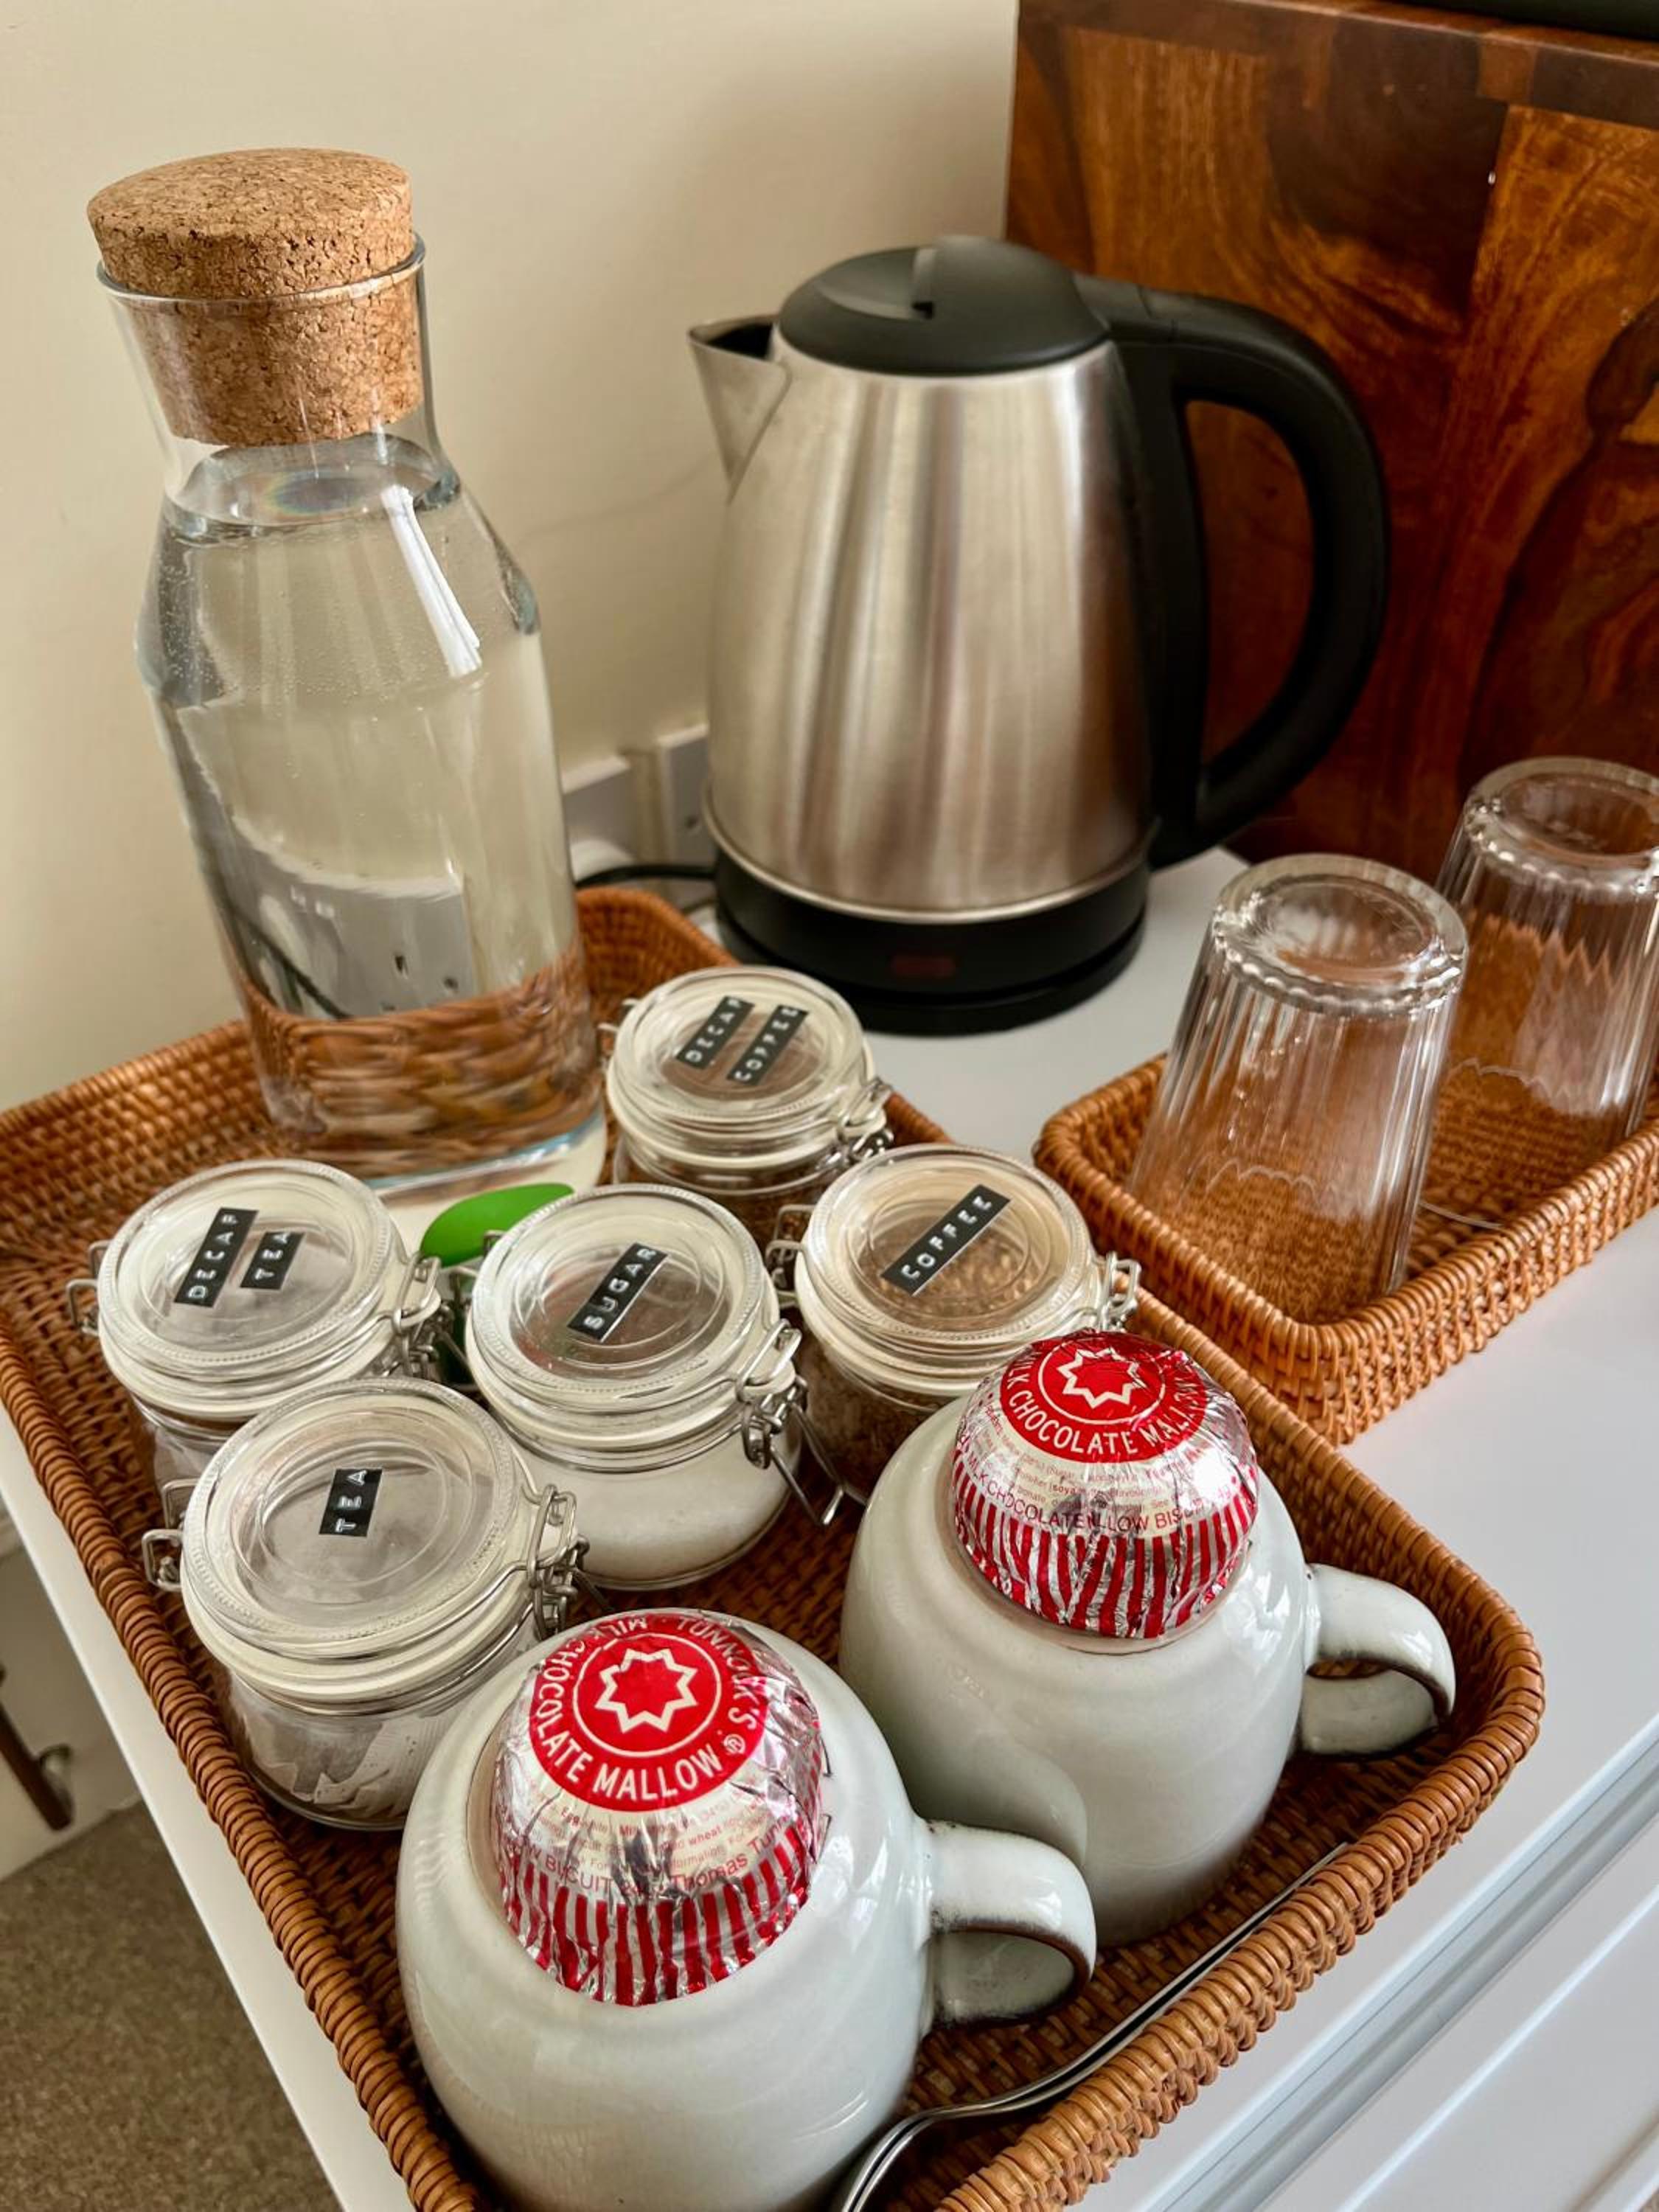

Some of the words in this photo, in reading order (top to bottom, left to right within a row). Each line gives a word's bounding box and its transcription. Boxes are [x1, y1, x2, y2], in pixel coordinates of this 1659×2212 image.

[685, 997, 741, 1063] DECAF
[734, 1007, 799, 1081] COFFEE
[187, 1214, 239, 1299] DECAF
[254, 1232, 292, 1280] TEA
[900, 1195, 992, 1279] COFFEE
[582, 1248, 657, 1329] SUGAR
[1009, 1390, 1138, 1455] CHOCOLATE
[334, 1470, 368, 1533] TEA
[536, 1638, 593, 1784] CHOCOLATE
[592, 1743, 723, 1801] MALLOW
